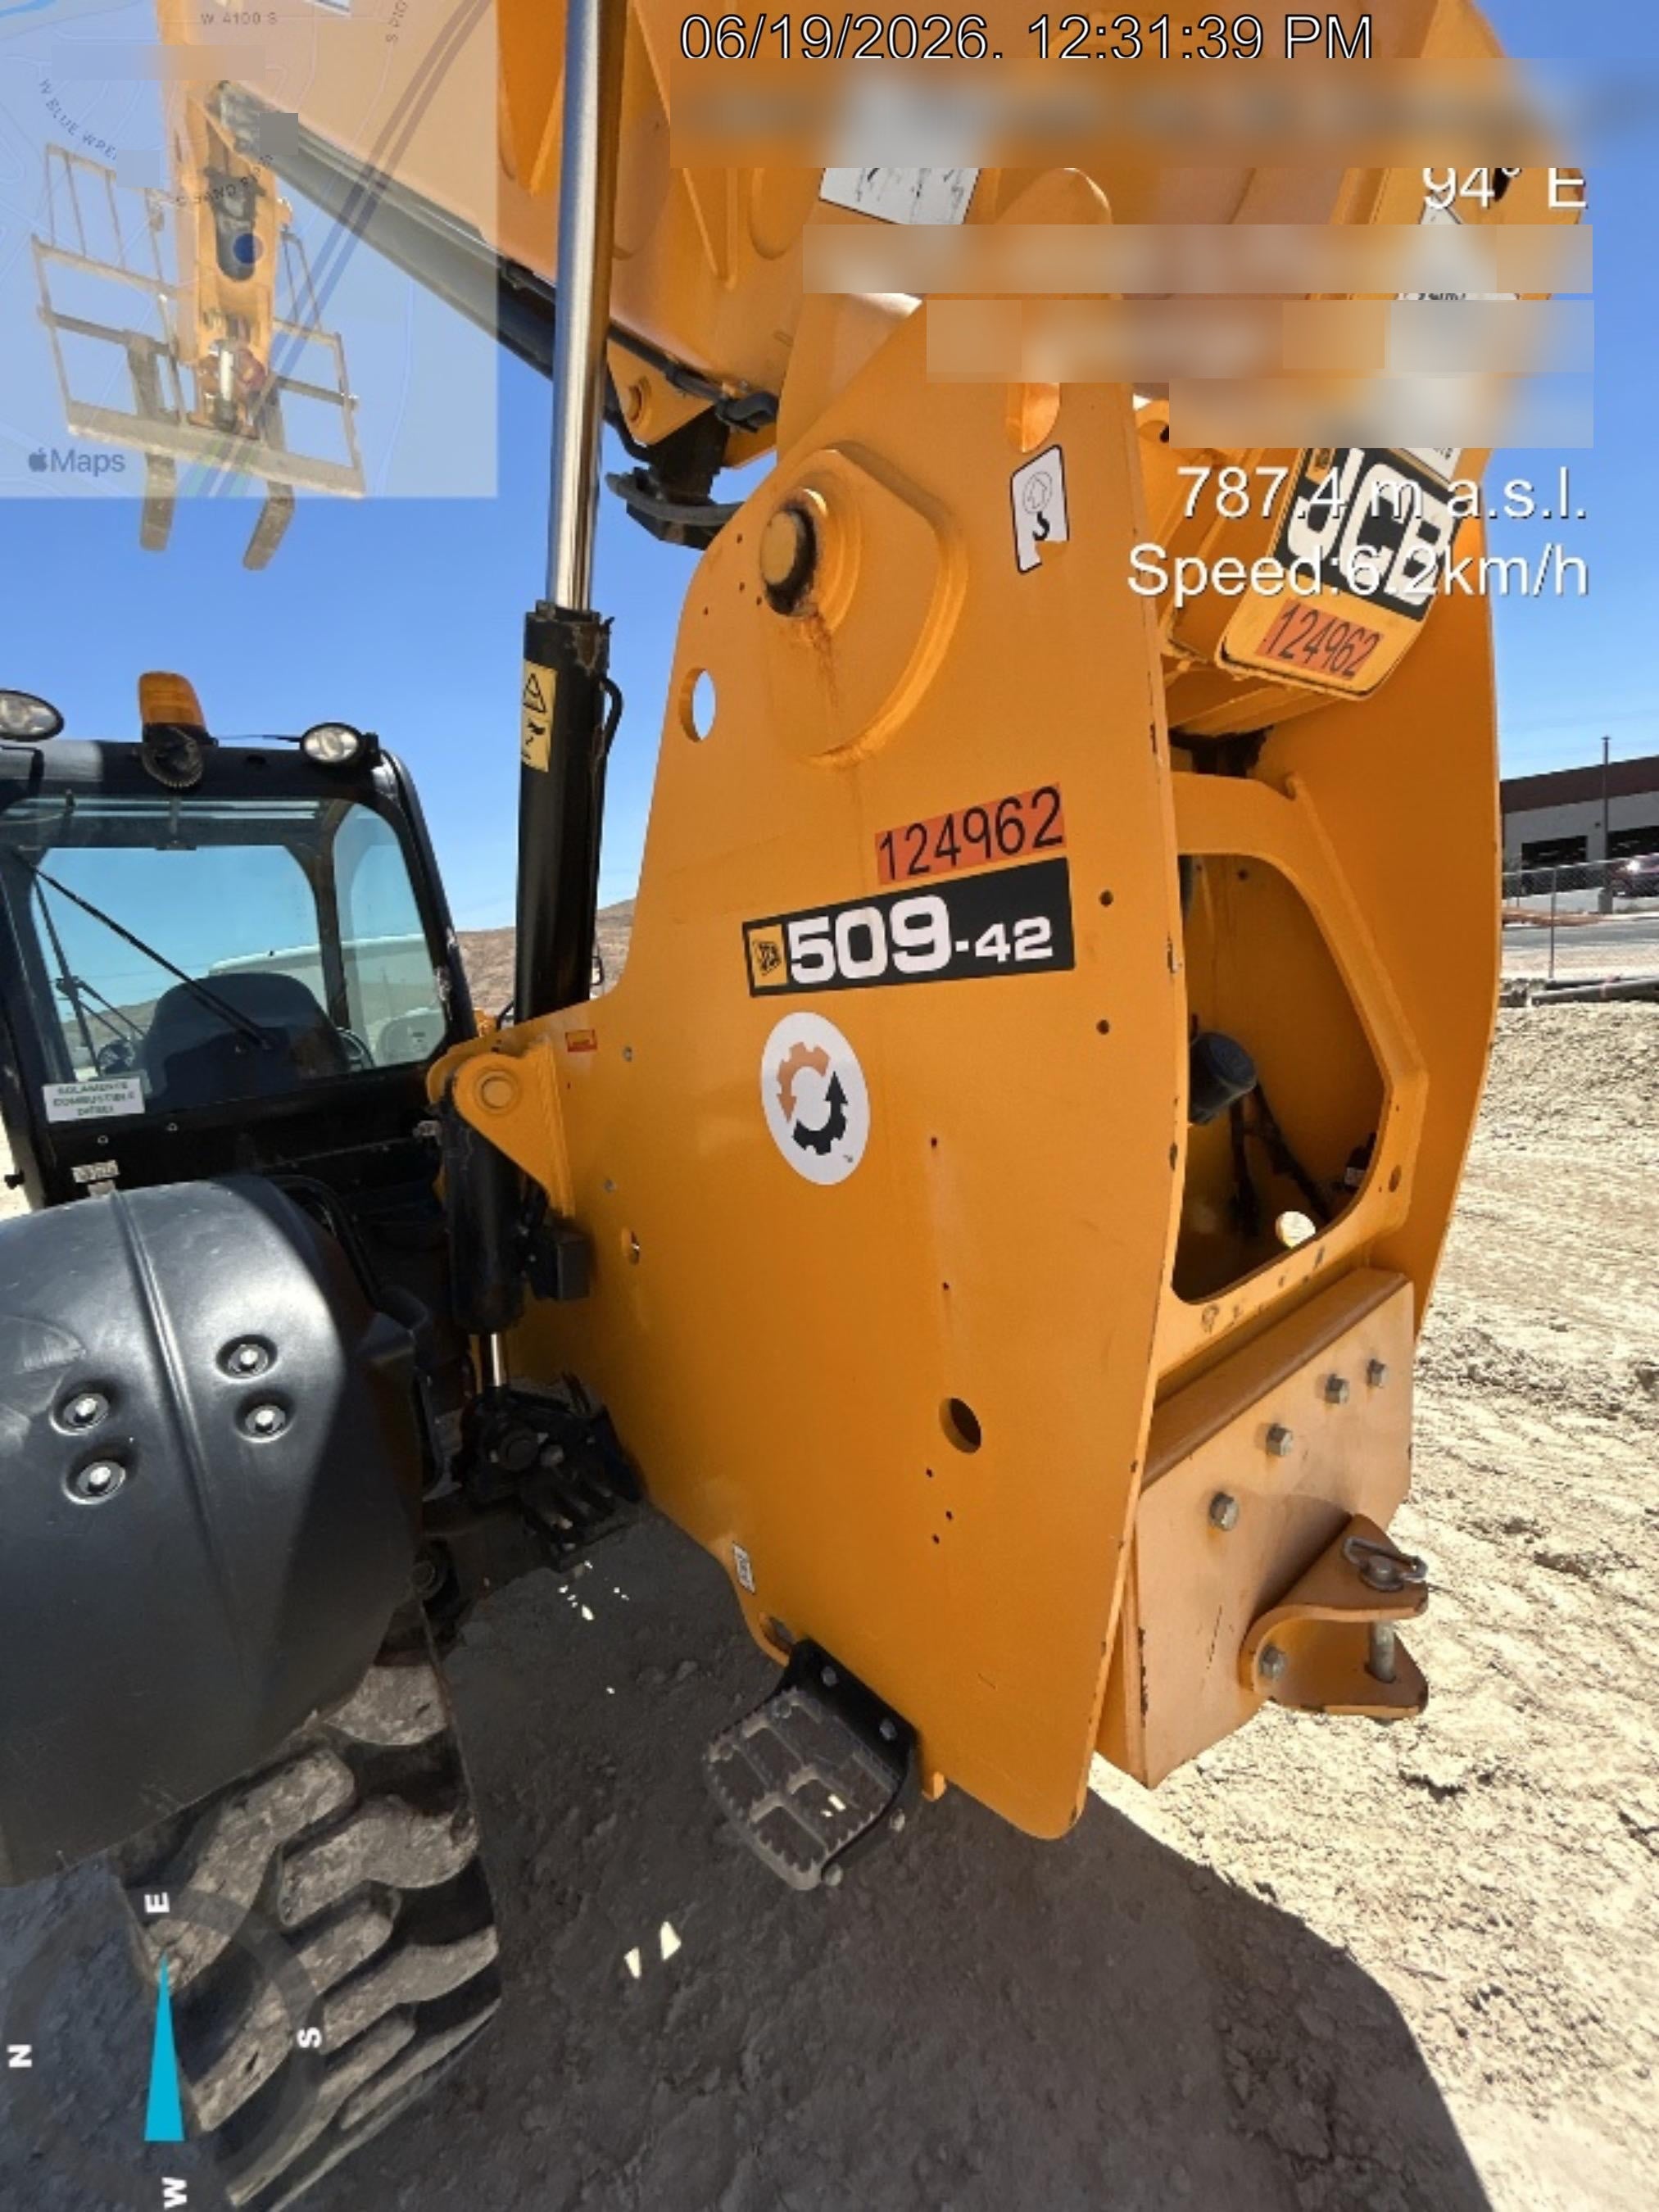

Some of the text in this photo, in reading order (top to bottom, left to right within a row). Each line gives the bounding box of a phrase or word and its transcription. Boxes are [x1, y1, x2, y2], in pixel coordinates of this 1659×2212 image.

[1267, 604, 1382, 678] 124962
[879, 785, 1063, 881] 124962
[788, 895, 1054, 983] 509-42
